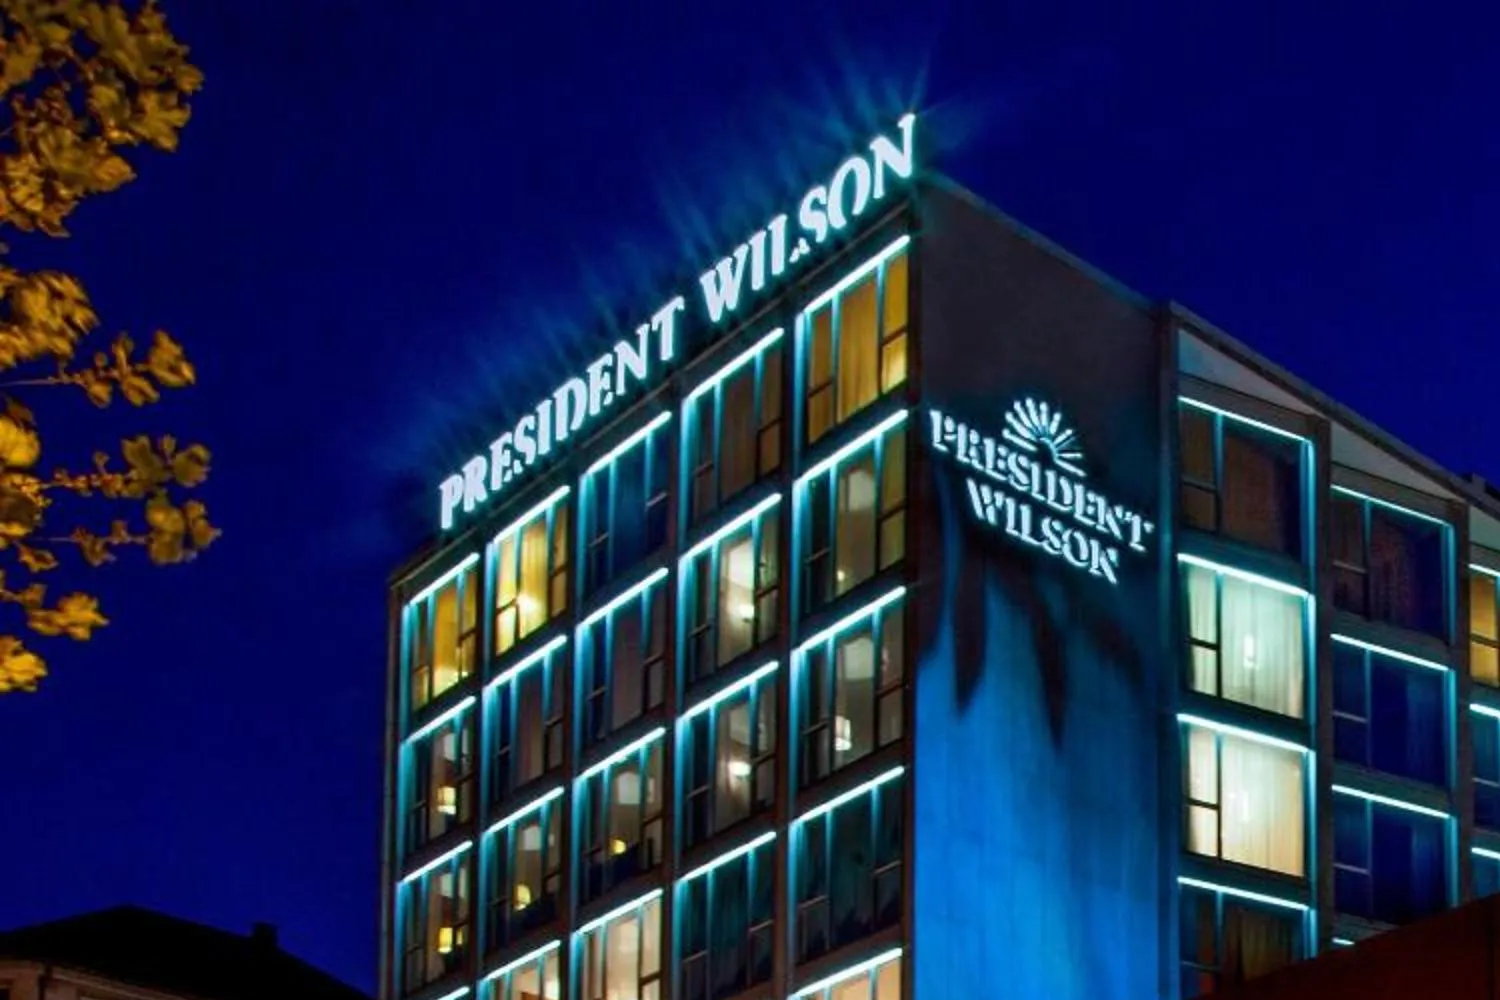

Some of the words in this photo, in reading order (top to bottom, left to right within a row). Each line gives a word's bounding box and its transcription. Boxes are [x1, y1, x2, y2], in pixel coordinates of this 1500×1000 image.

[439, 296, 684, 530] PRESIDENT
[700, 113, 916, 322] WILSON
[929, 409, 1154, 552] PRESIDENT
[966, 479, 1120, 584] WILSON
